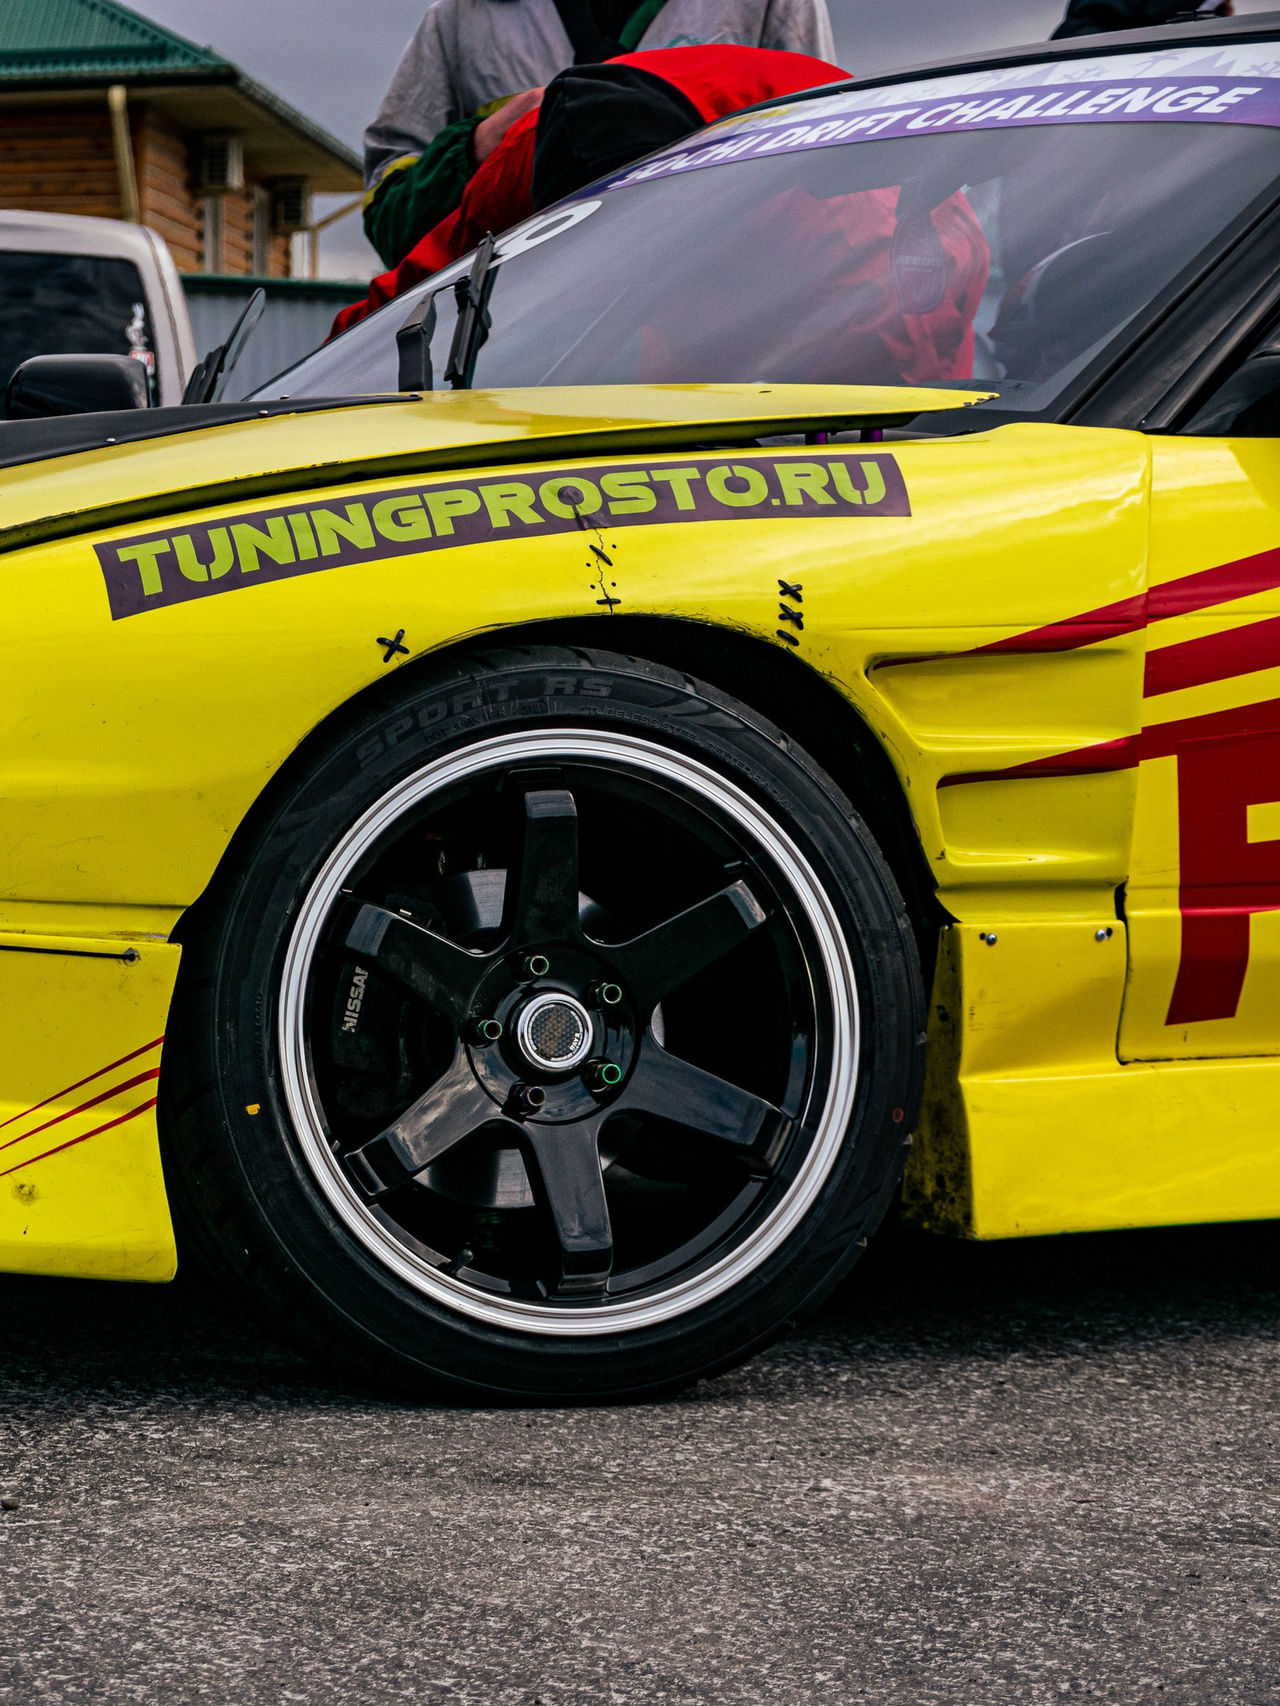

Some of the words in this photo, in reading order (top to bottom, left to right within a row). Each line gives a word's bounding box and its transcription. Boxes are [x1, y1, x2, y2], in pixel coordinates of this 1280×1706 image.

[607, 132, 767, 189] SOCHI
[753, 107, 923, 153] DRIFT
[906, 85, 1263, 131] CHALLENGE
[116, 460, 887, 597] TUNINGPROSTO.RU
[355, 679, 521, 770] SPORT
[544, 676, 615, 698] RS
